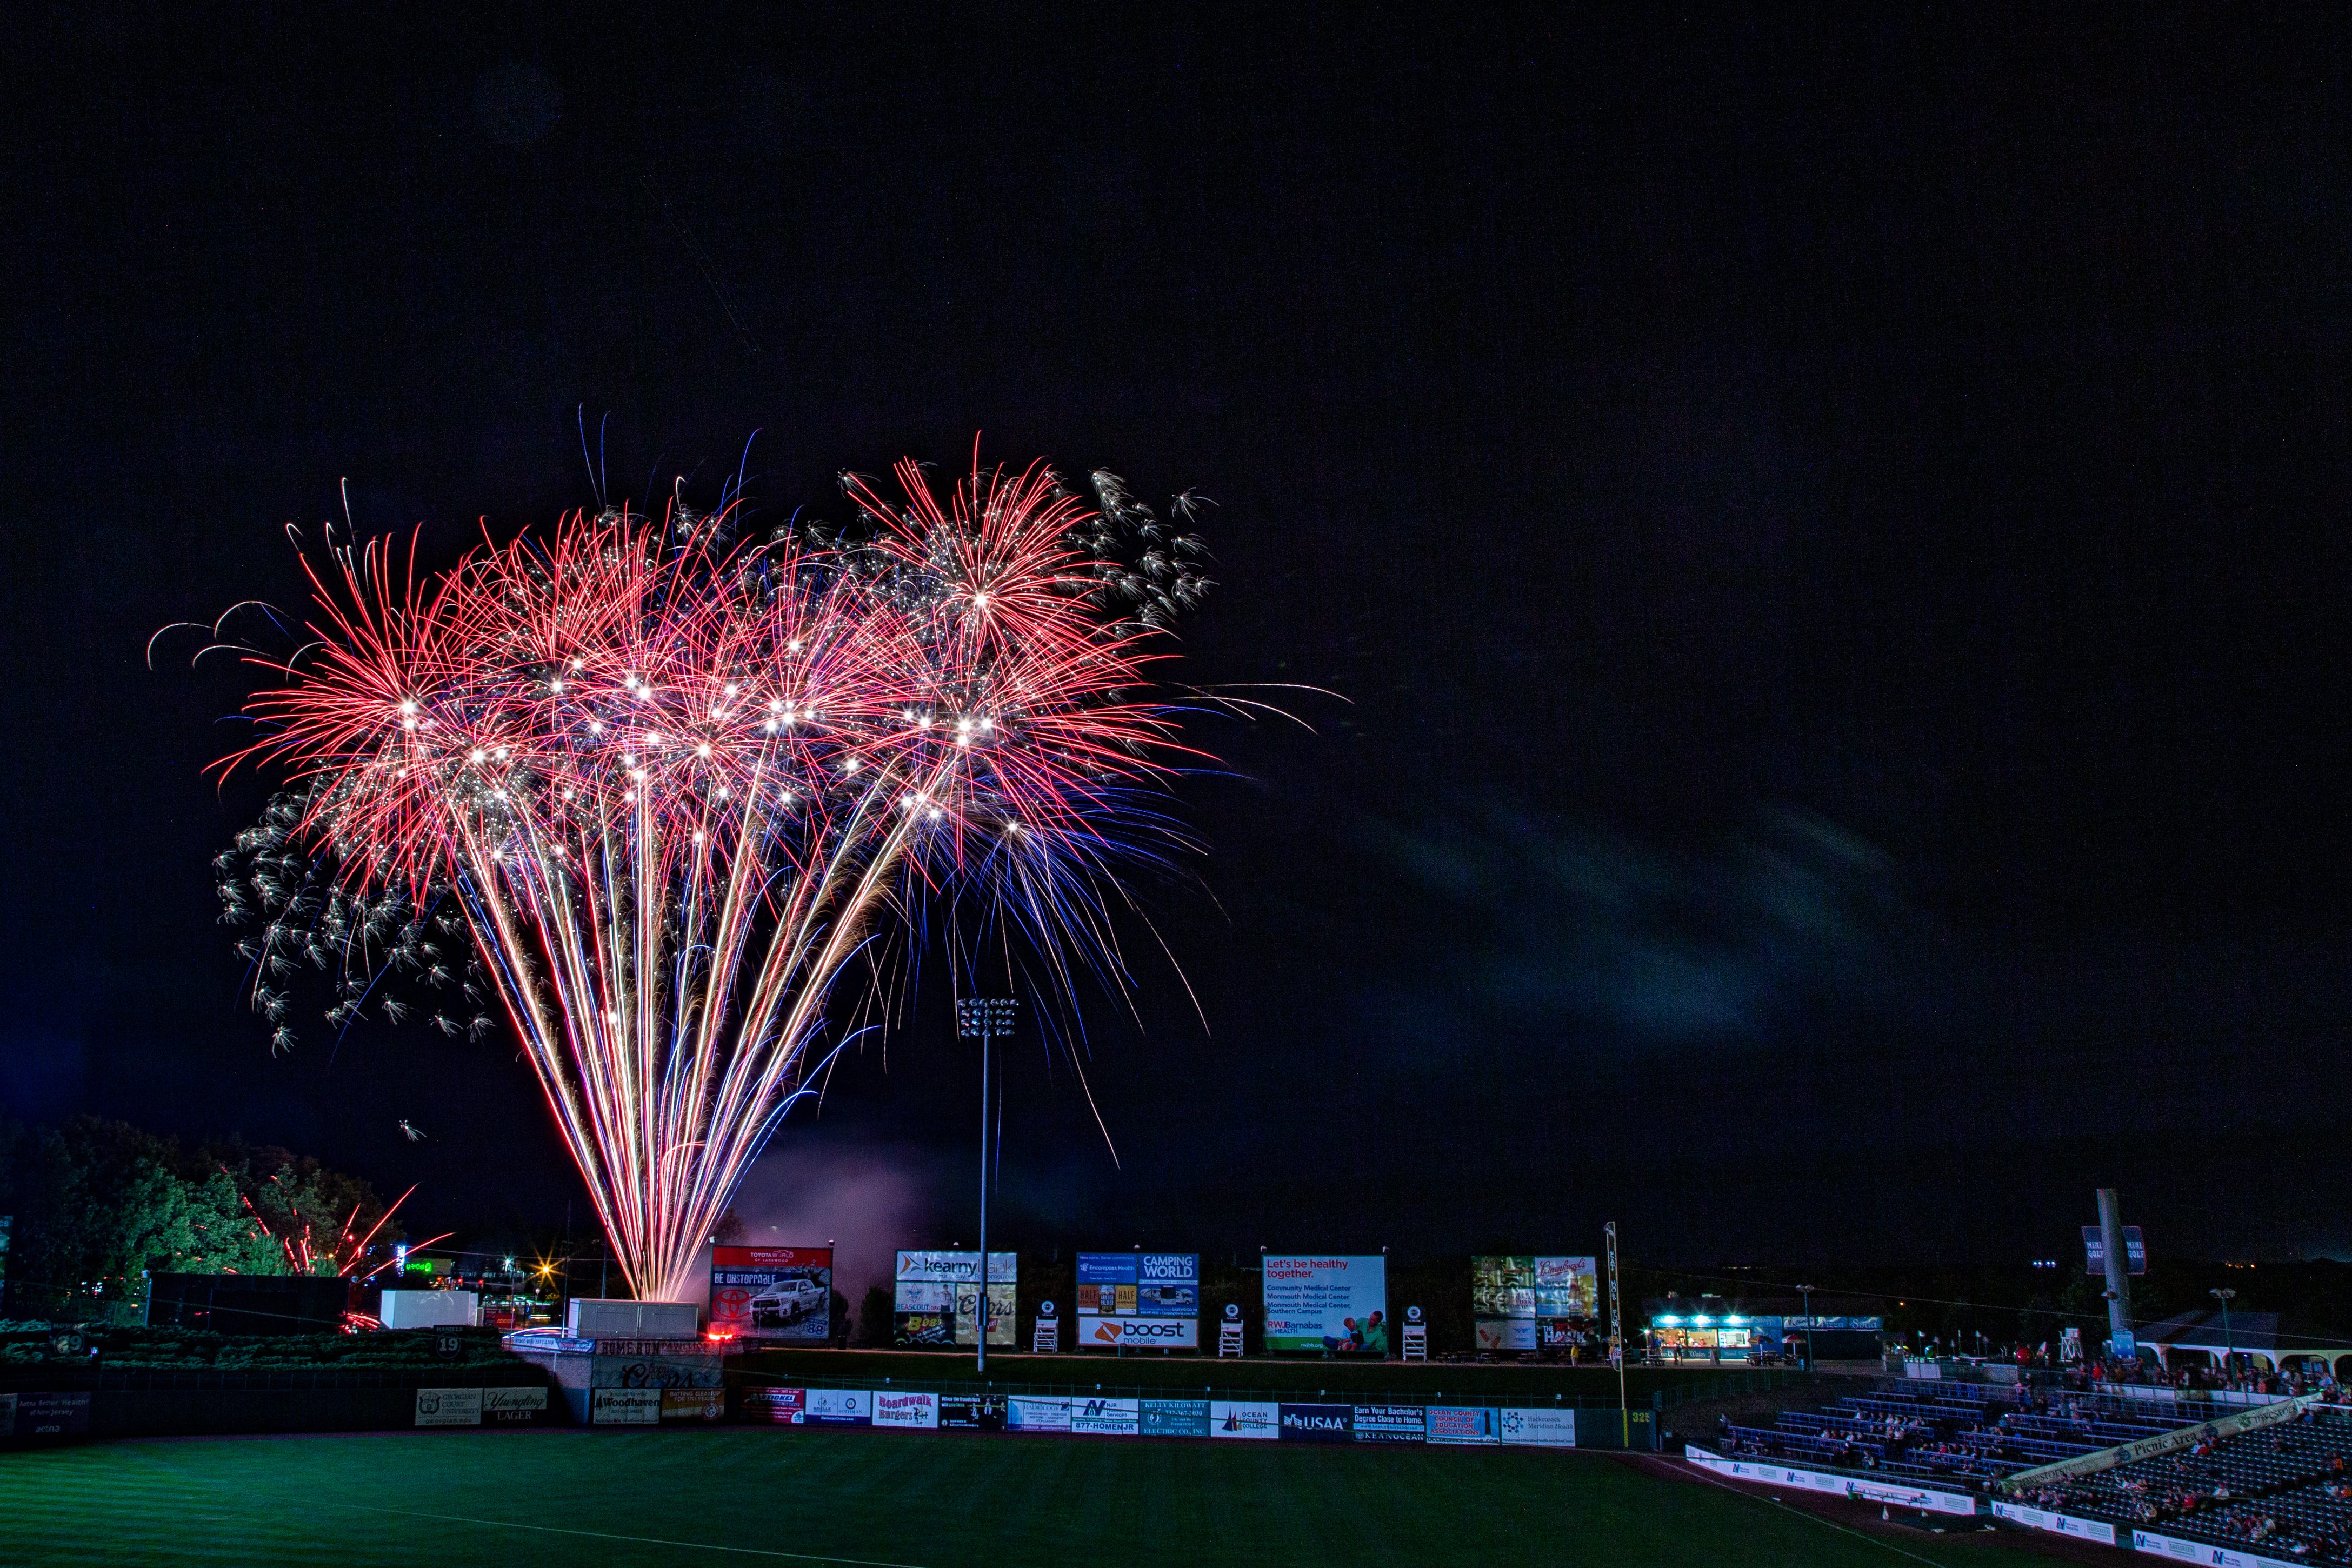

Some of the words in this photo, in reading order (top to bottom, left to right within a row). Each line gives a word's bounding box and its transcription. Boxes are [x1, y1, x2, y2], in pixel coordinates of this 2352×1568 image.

[1143, 1256, 1193, 1266] CAMPING
[1267, 1259, 1291, 1269] Let's
[1294, 1259, 1307, 1269] be
[1310, 1259, 1348, 1270] healthy
[1144, 1265, 1193, 1277] WORLD
[1267, 1270, 1314, 1279] together.
[715, 1273, 724, 1284] BE
[727, 1273, 776, 1284] UNSTOPPABLE
[1081, 1290, 1097, 1299] HALF
[1118, 1291, 1134, 1300] HALF
[958, 1295, 1014, 1316] Cors
[1268, 1321, 1323, 1330] RWJBarnabas
[1851, 1318, 1878, 1328] Soda
[807, 1324, 823, 1335] 88
[1123, 1321, 1184, 1337] boost
[1544, 1331, 1587, 1343] HAWK
[439, 1338, 459, 1351] 19
[602, 1342, 634, 1355] HOME
[636, 1342, 659, 1355] RUN
[488, 1392, 544, 1410] Yuengling
[603, 1398, 660, 1406] Woodhaven
[879, 1395, 932, 1408] Boardwalk
[497, 1411, 532, 1420] LAGER
[878, 1409, 913, 1420] Burgers
[1354, 1406, 1369, 1414] Earn
[1388, 1407, 1423, 1416] Bachelor's
[1304, 1417, 1343, 1430] USAA
[1355, 1415, 1376, 1423] Degree
[35, 1425, 61, 1433] aetna
[1075, 1422, 1134, 1430] 877-HOMENJR
[2133, 1438, 2168, 1456] Picnic
[2171, 1431, 2197, 1445] Area
